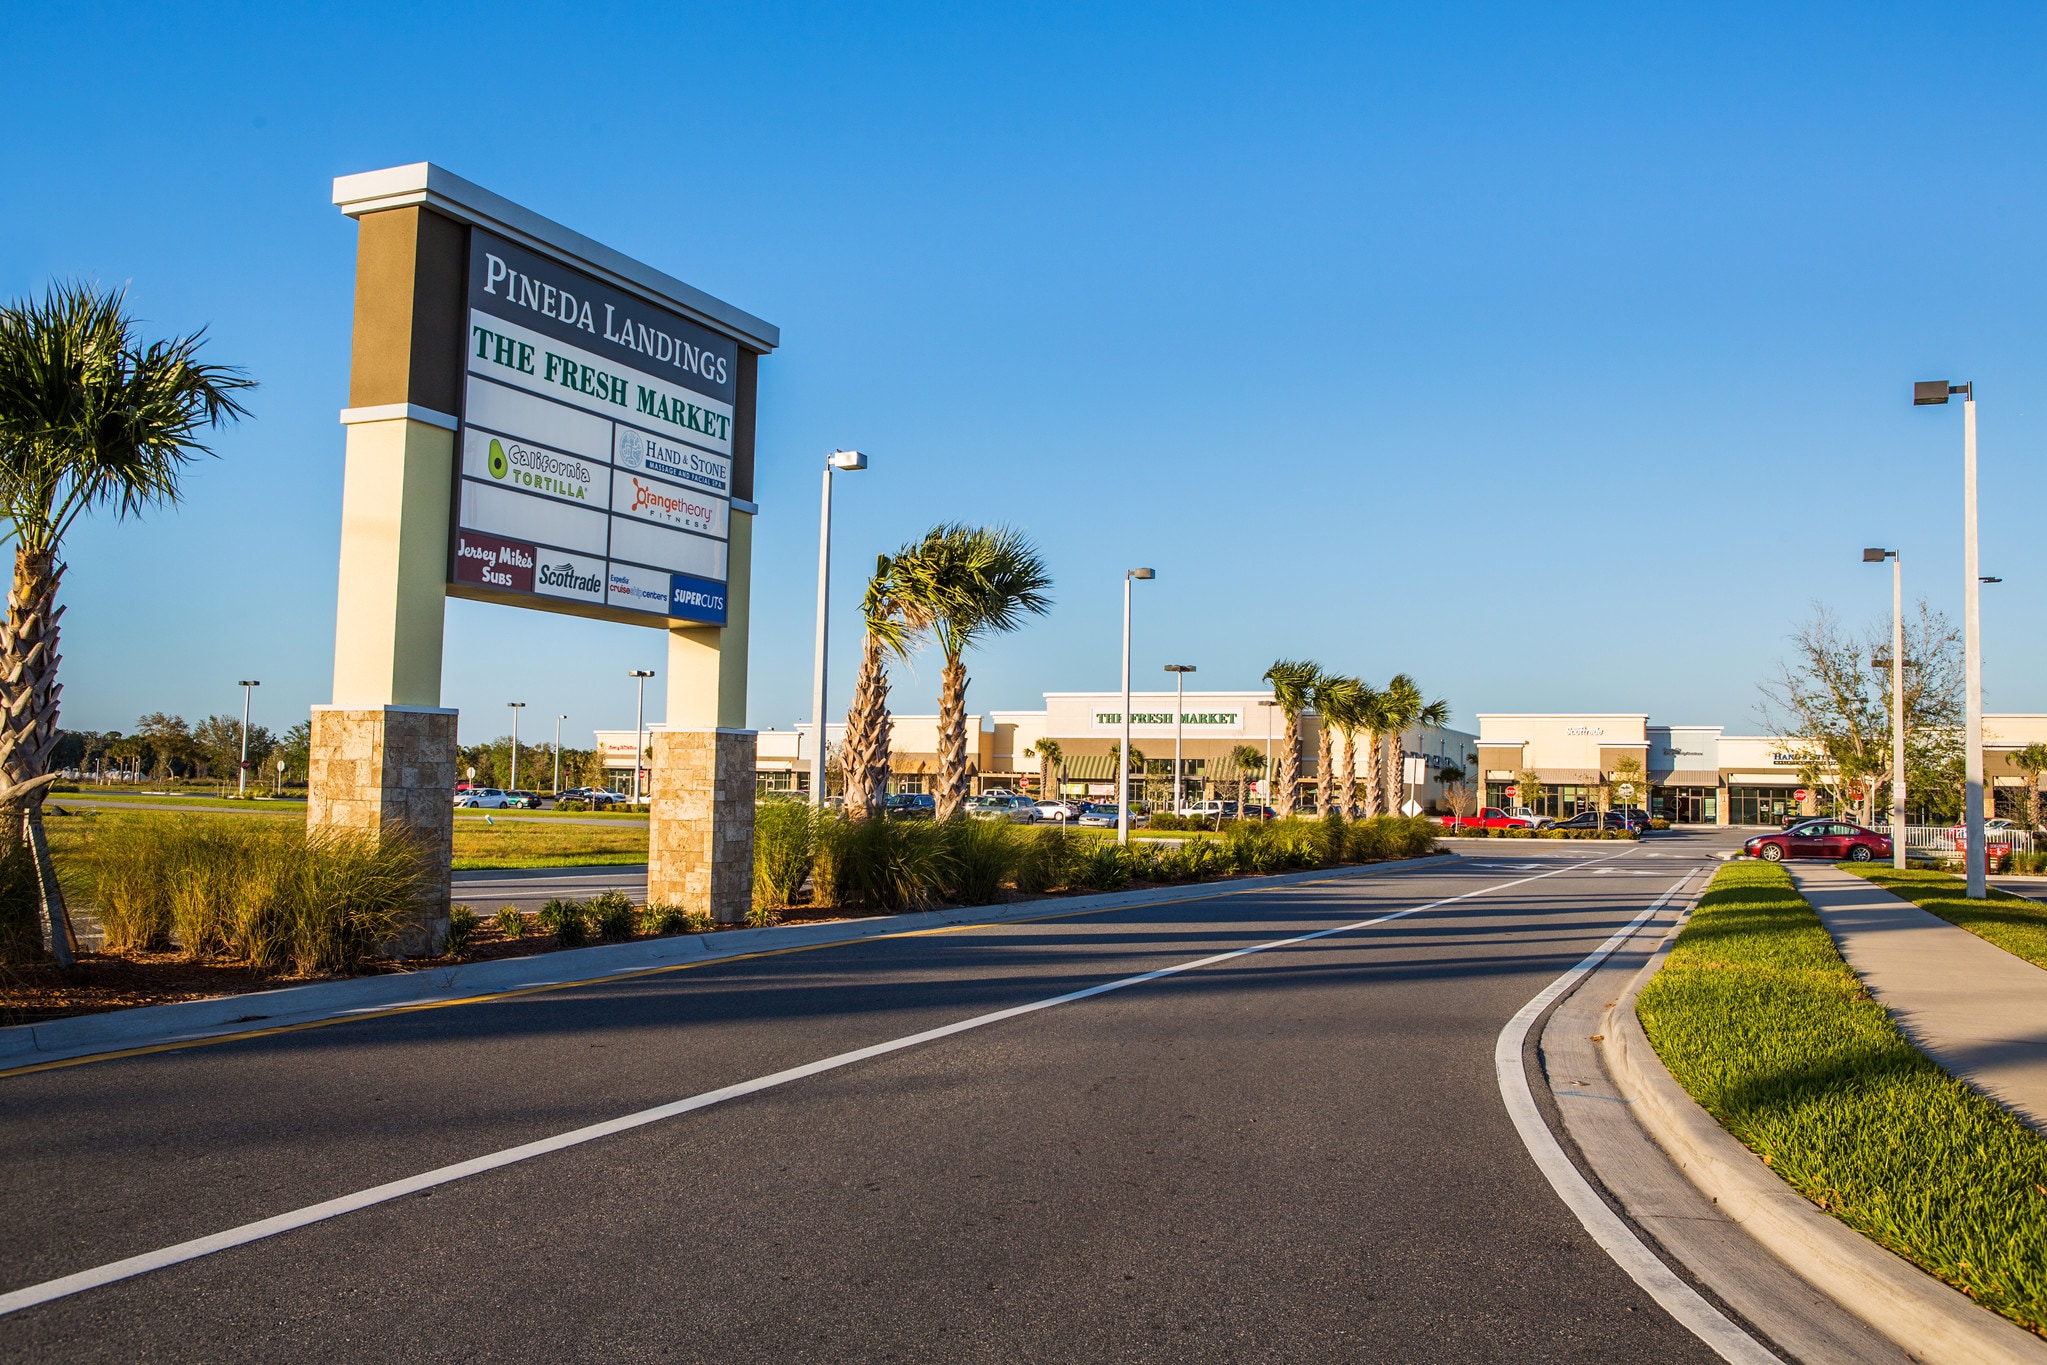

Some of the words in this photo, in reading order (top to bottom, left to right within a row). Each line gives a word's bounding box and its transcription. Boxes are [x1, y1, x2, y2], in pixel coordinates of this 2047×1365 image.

[483, 253, 596, 334] PINEDA
[604, 303, 728, 385] LANDINGS
[473, 325, 536, 376] THE
[544, 351, 629, 408] FRESH
[636, 384, 731, 442] MARKET
[508, 445, 591, 483] California
[646, 440, 681, 465] HAND
[682, 455, 689, 465] &
[690, 454, 727, 479] STONE
[649, 461, 677, 475] MASSAGE
[679, 470, 691, 479] AND
[691, 473, 711, 484] FACIAL
[711, 480, 722, 488] SPA
[513, 469, 585, 500] TORTILLA
[632, 477, 712, 522] Orangetheory
[650, 510, 708, 530] FITNESS
[458, 538, 497, 566] Jersey
[499, 547, 534, 568] Mike's
[482, 567, 513, 586] SUBS
[539, 563, 601, 593] Scottrade
[610, 574, 630, 585] Expedia
[674, 589, 724, 610] SUPERCUTS
[1129, 713, 1174, 724] FRESH
[1180, 713, 1237, 724] MARKET
